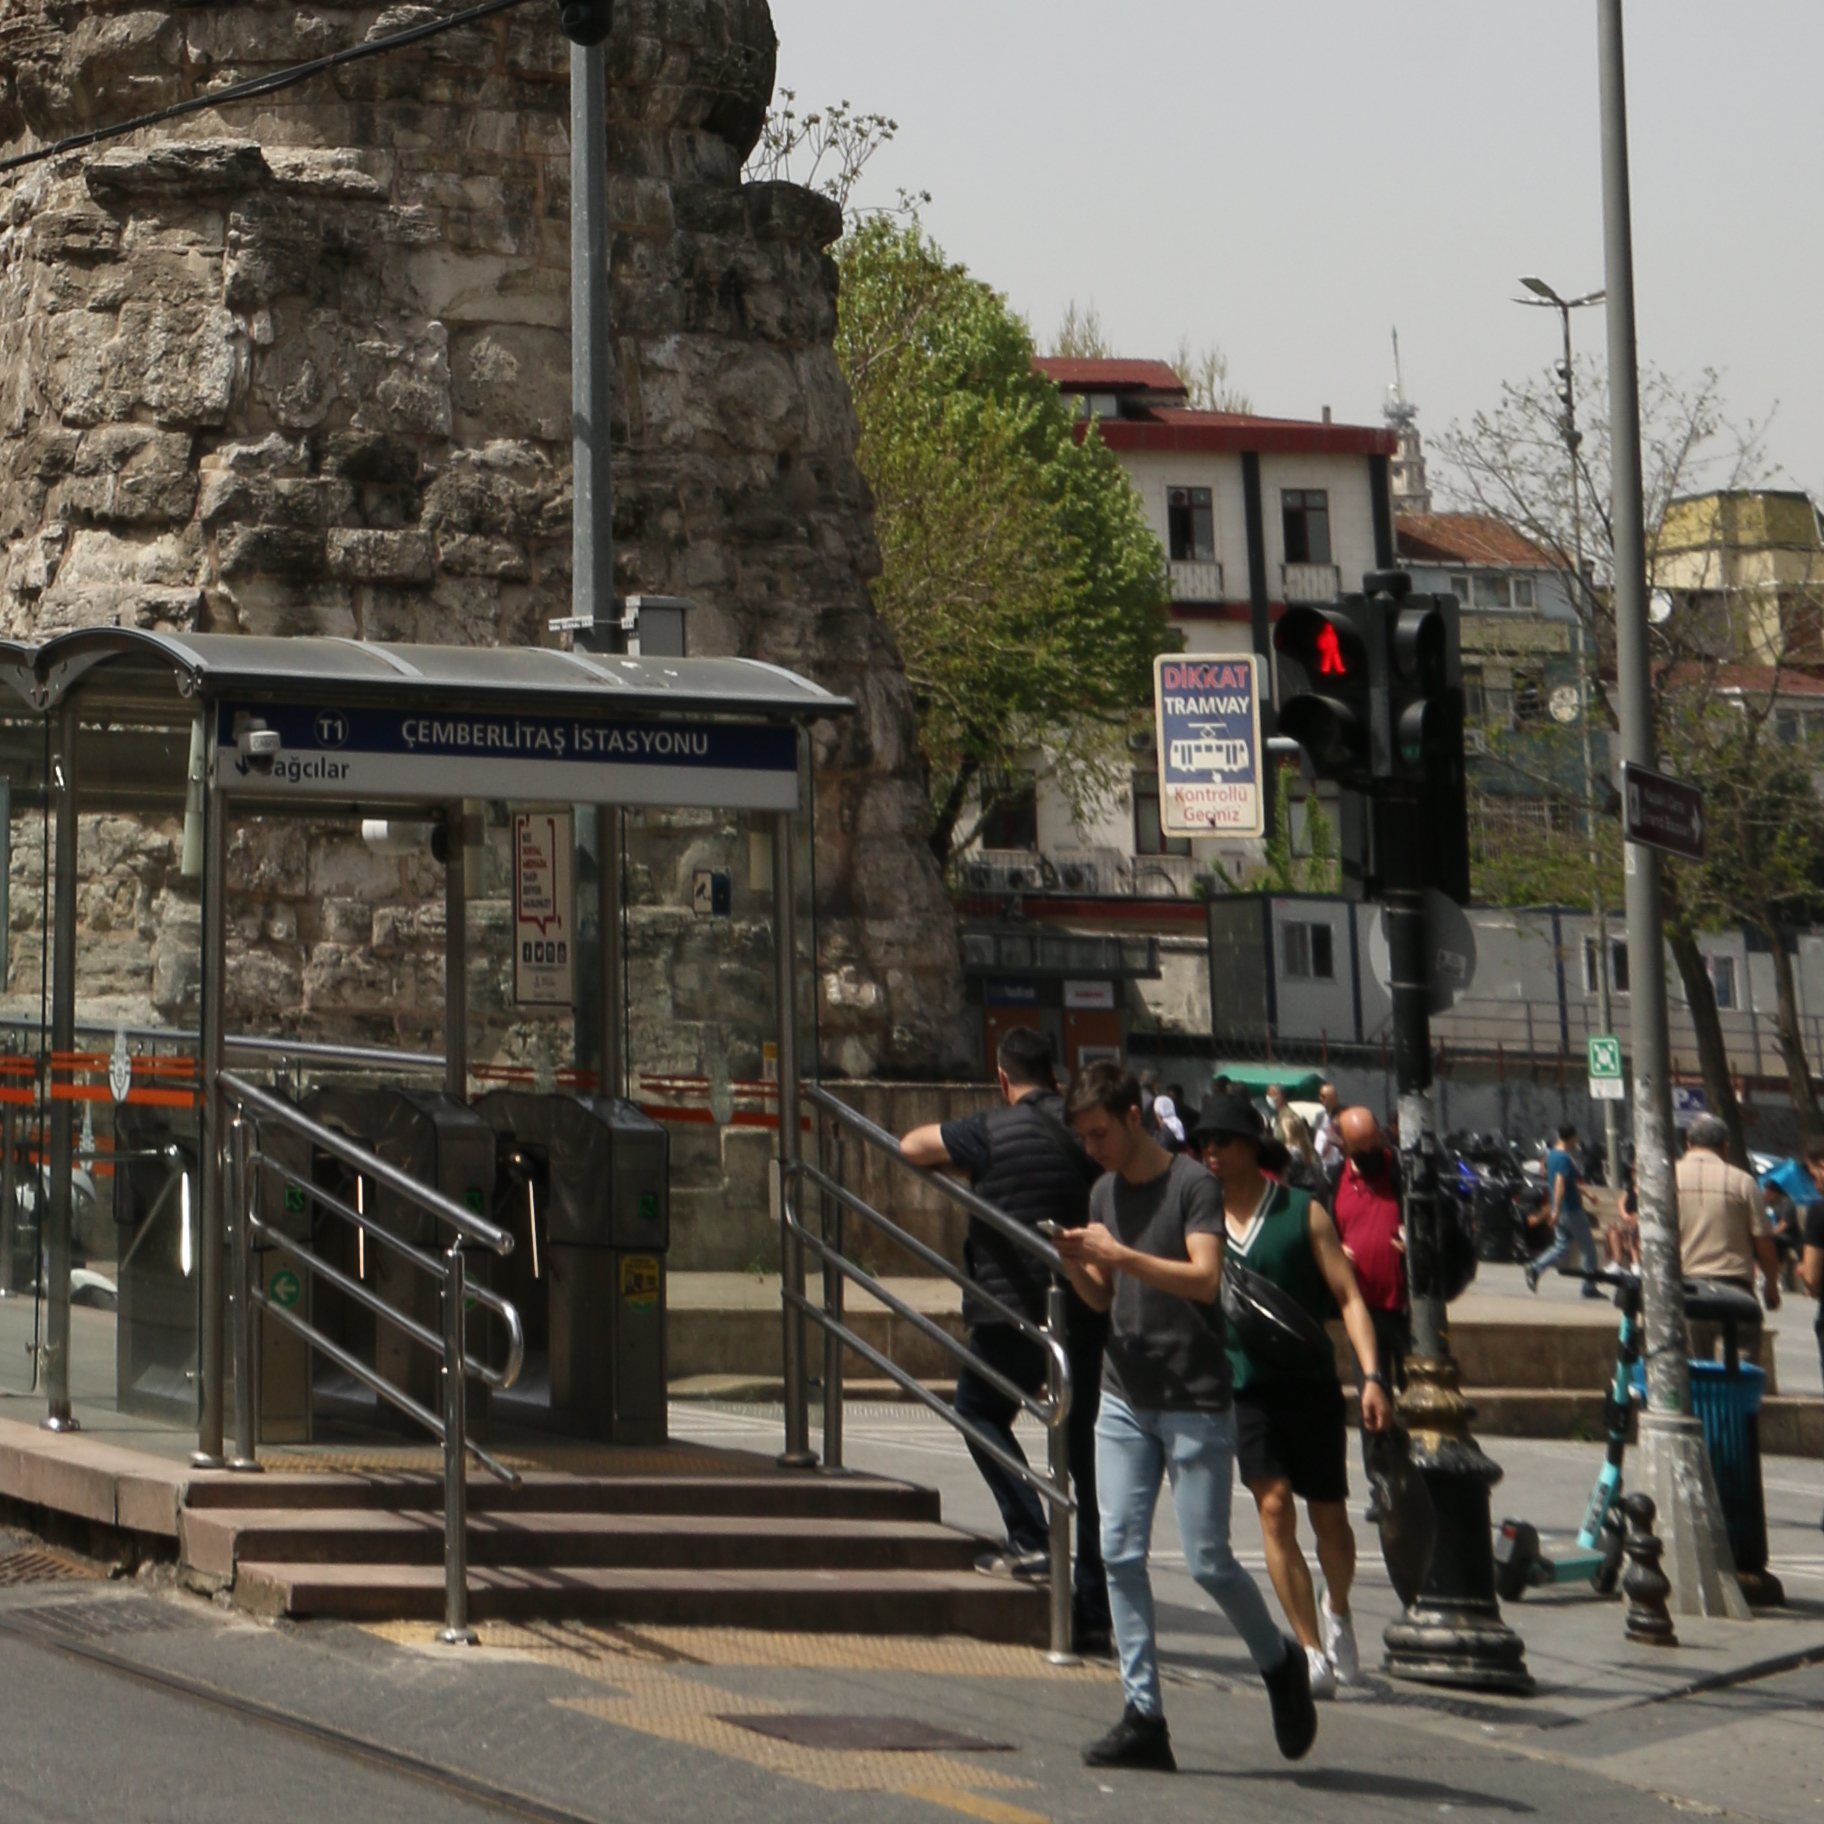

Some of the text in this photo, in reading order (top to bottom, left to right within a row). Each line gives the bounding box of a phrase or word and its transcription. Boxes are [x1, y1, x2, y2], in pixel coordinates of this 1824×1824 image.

[1164, 663, 1249, 689] DİKKAT
[1164, 696, 1250, 715] TRAMVAY
[318, 718, 709, 756] T1 ÇEMBERLİTAŞ İSTASYONU
[270, 756, 350, 783] ağcılar
[1174, 786, 1248, 802] Kontrollü
